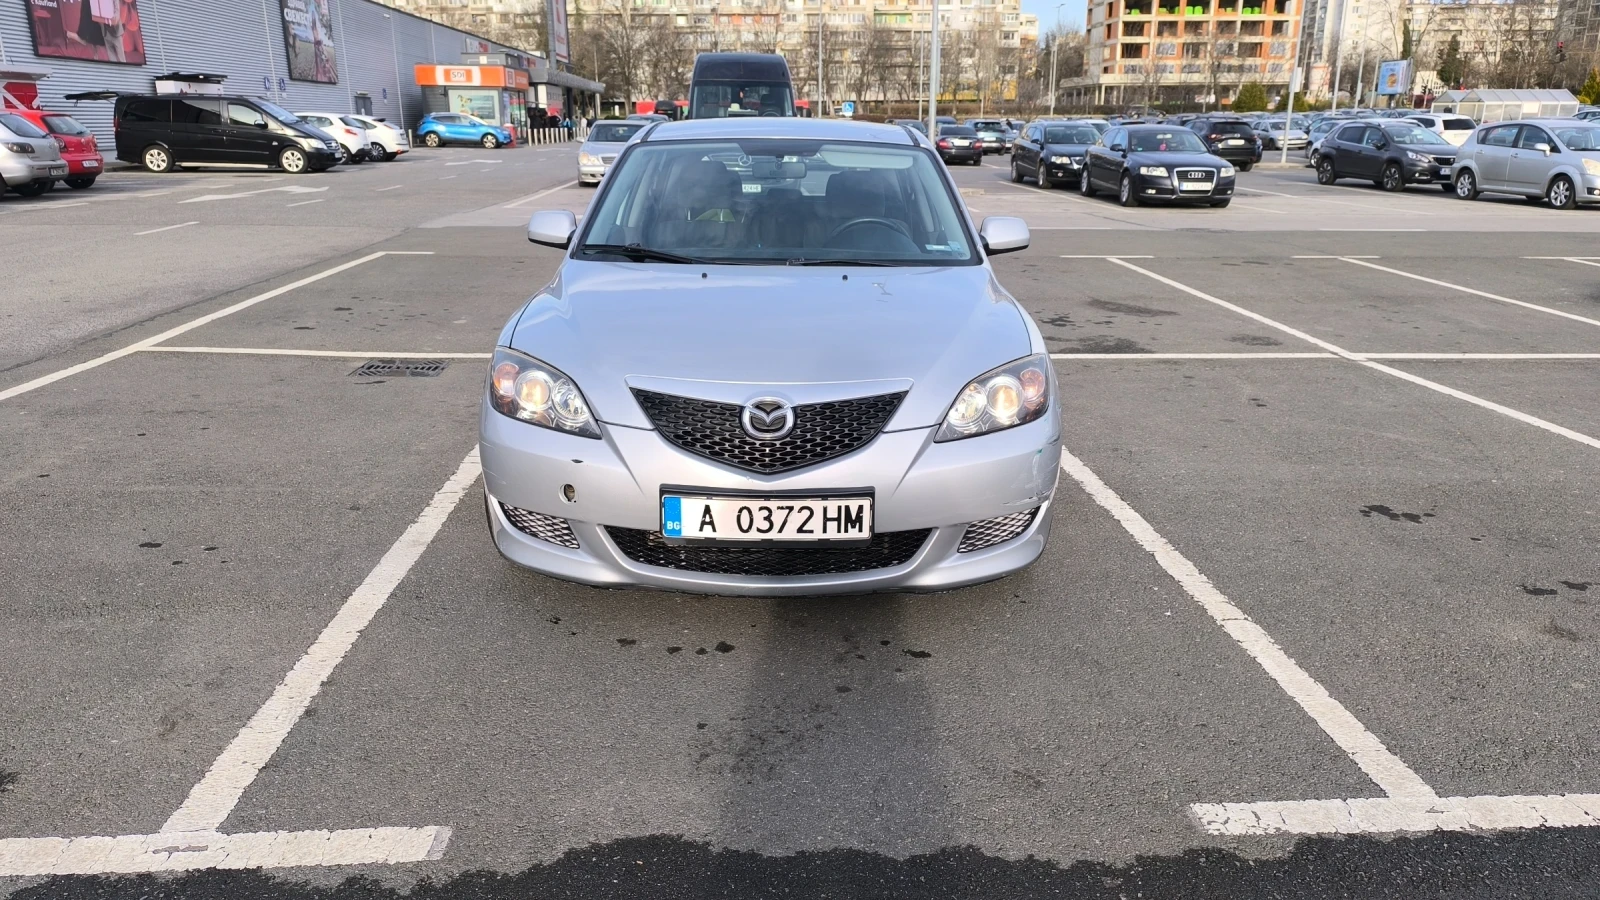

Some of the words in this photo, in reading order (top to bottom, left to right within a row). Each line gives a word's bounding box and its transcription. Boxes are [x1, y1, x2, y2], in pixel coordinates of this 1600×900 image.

[666, 521, 680, 530] BG
[698, 504, 717, 533] A
[736, 505, 815, 534] 0372
[822, 504, 864, 534] HM
